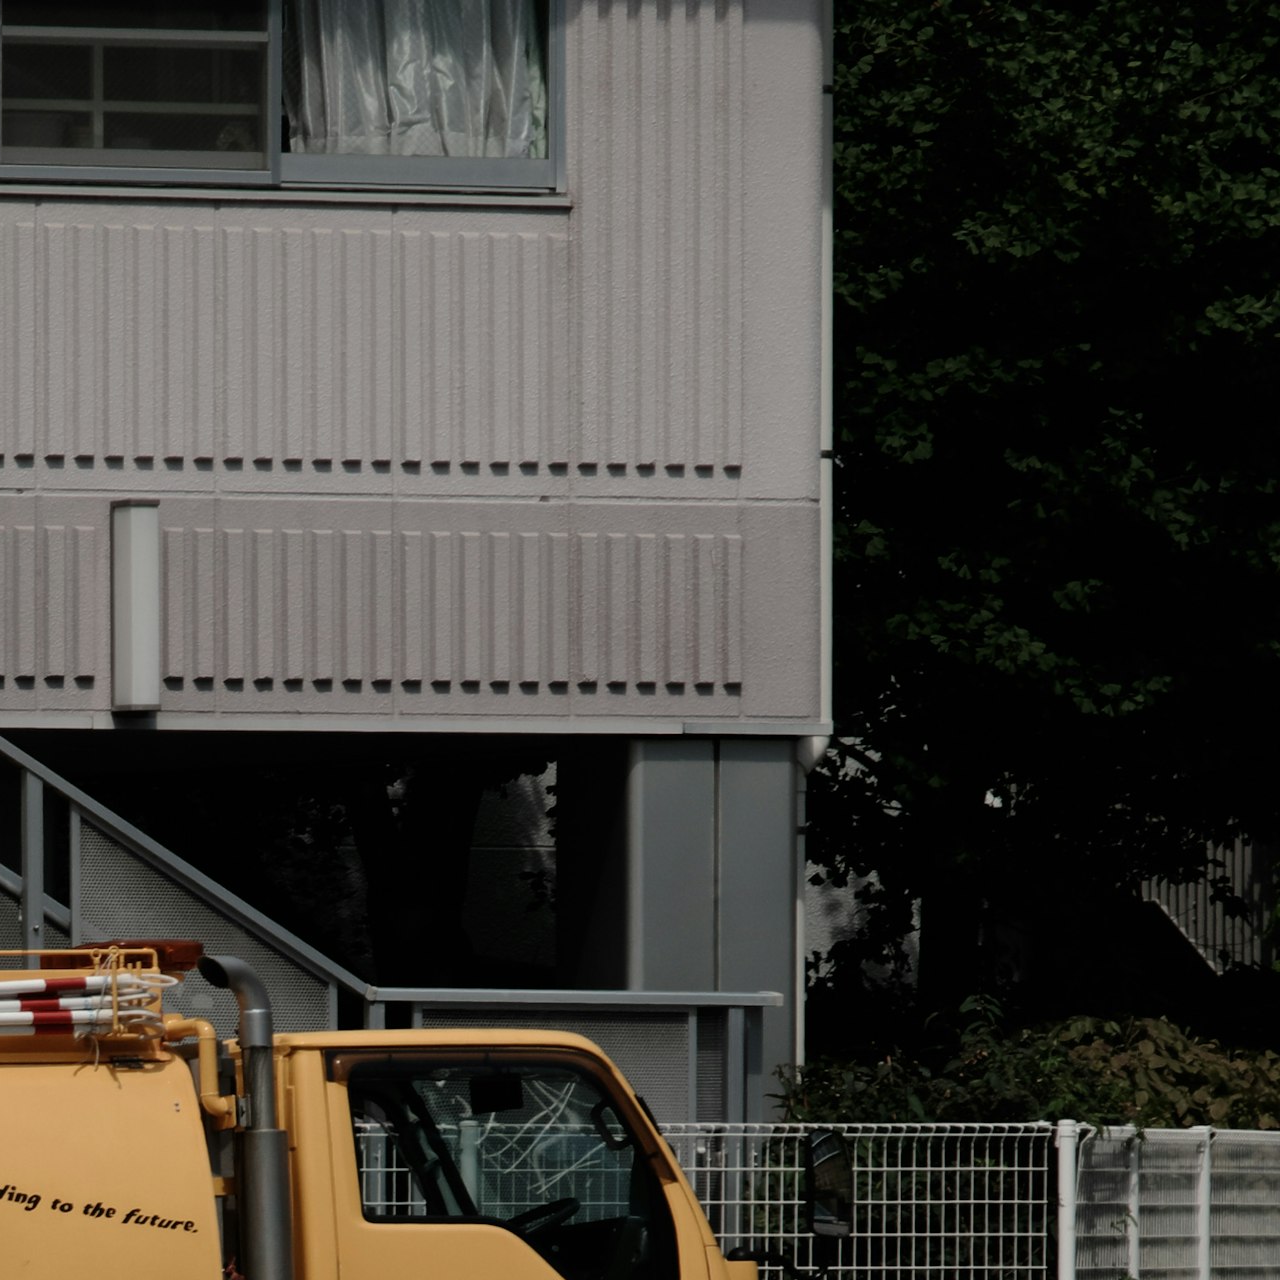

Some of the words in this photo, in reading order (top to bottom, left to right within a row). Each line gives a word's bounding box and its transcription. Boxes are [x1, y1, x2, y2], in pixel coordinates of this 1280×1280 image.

[50, 1198, 74, 1213] to
[82, 1202, 117, 1219] the
[121, 1208, 199, 1234] future.
